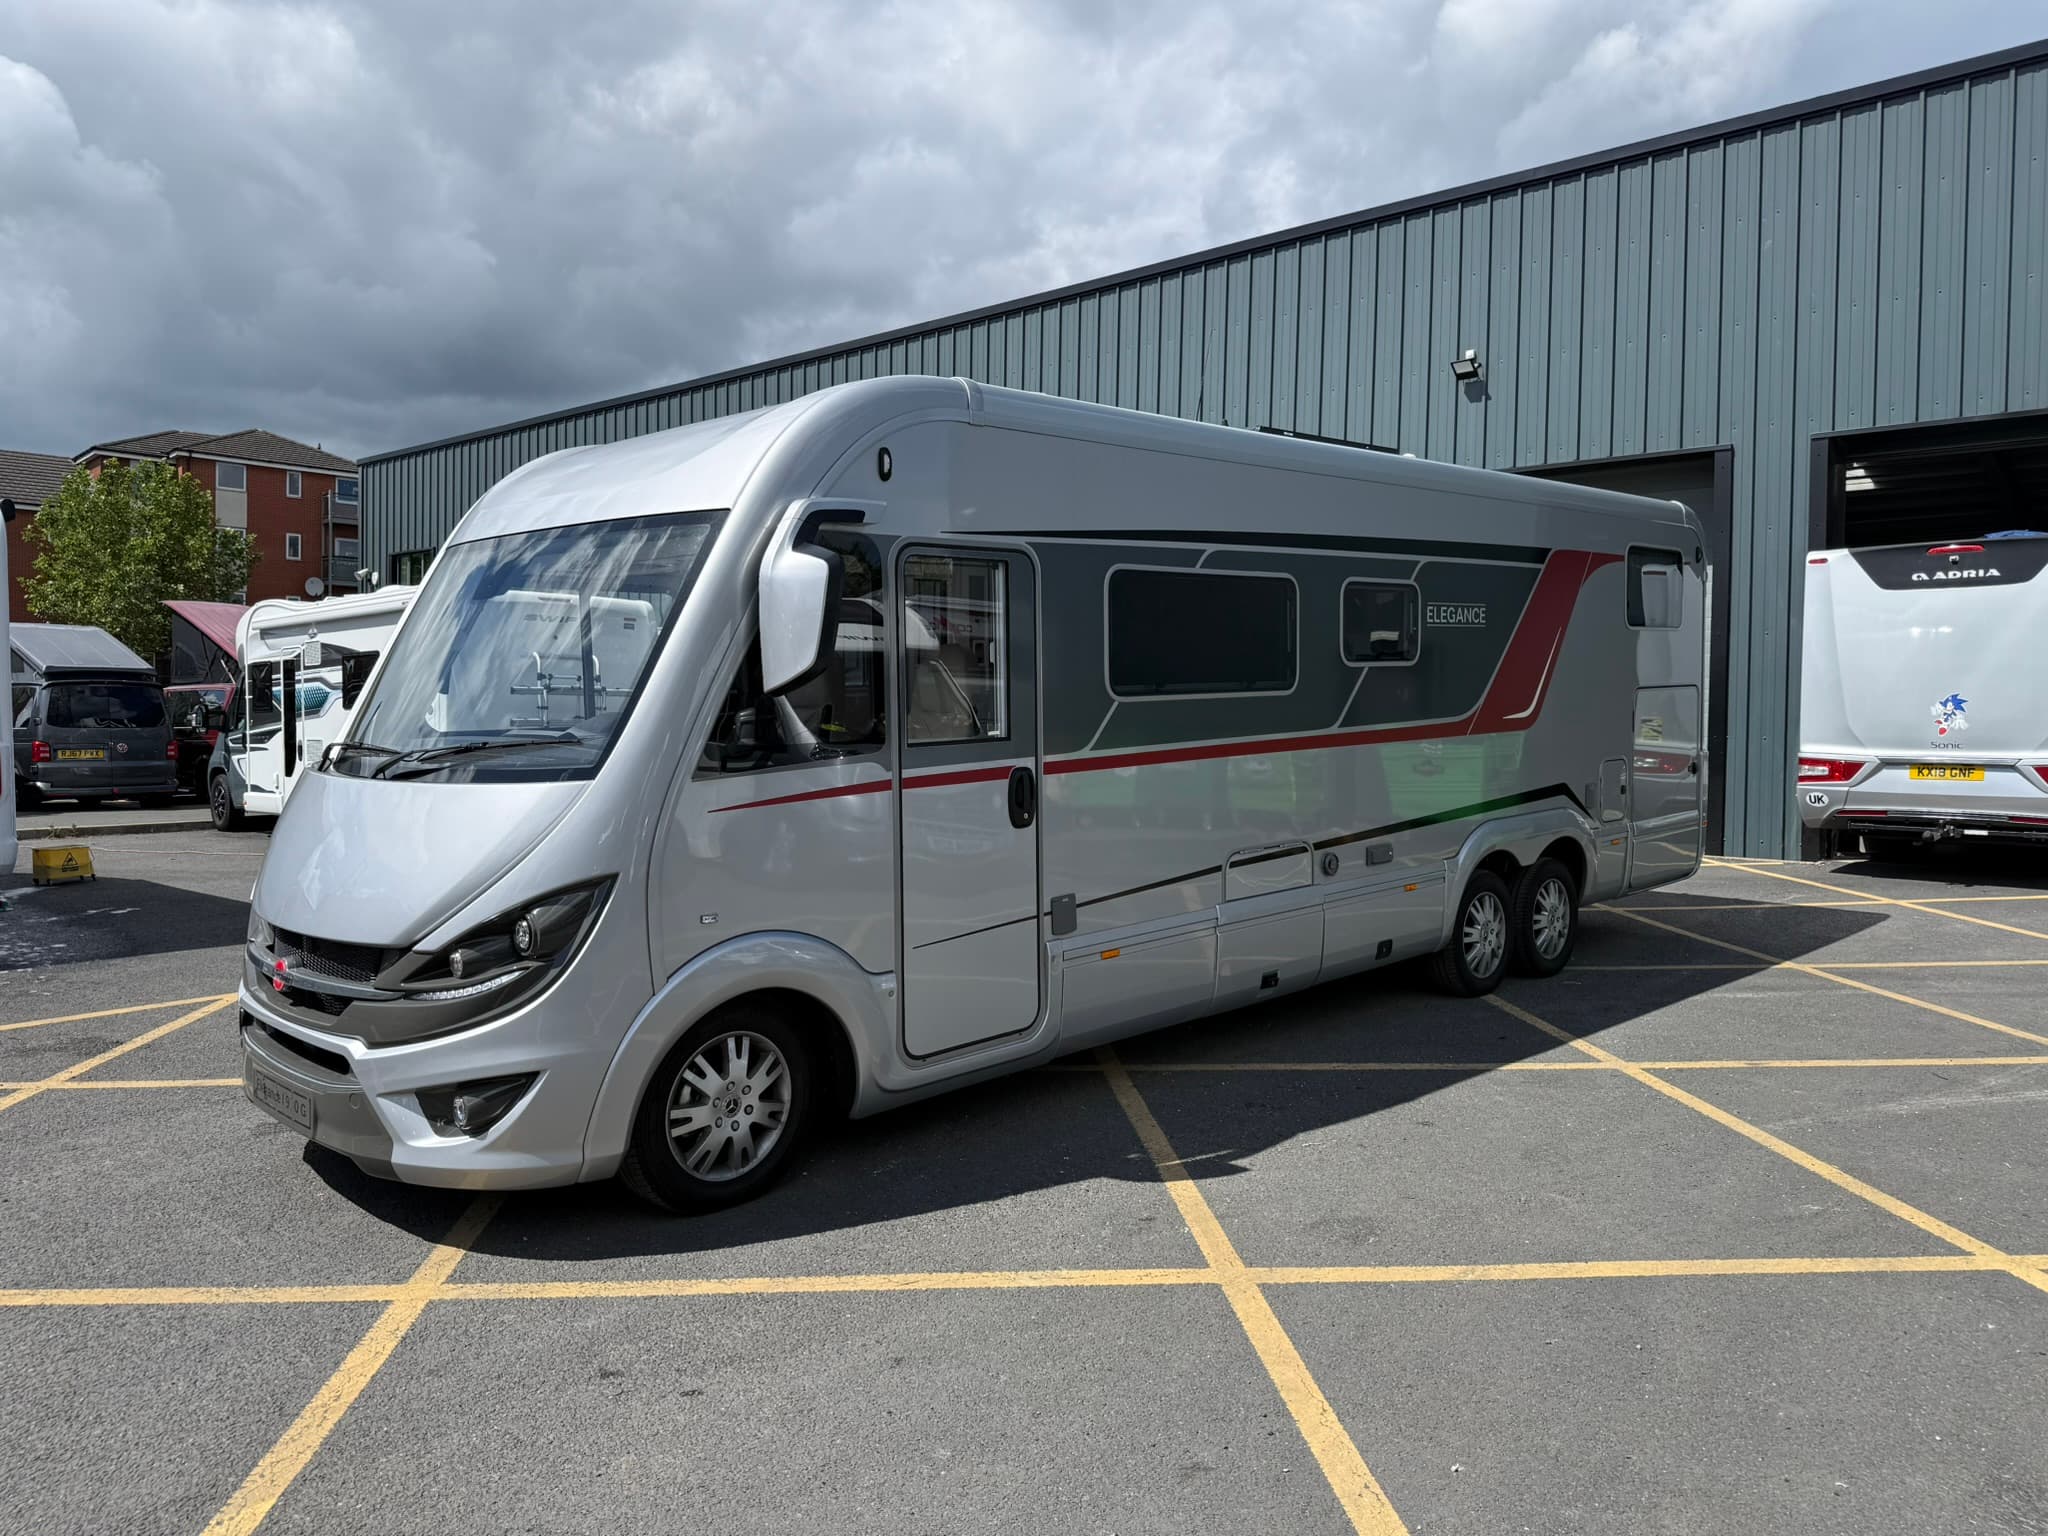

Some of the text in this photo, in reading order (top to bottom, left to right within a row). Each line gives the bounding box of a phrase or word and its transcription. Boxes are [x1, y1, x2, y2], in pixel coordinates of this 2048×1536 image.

[1932, 568, 2001, 580] ADRIA
[523, 613, 577, 623] SWIF
[1426, 605, 1487, 623] ELEGANCE
[1930, 741, 1964, 750] Sonic
[1949, 767, 1976, 778] GNF
[1808, 794, 1825, 805] UK
